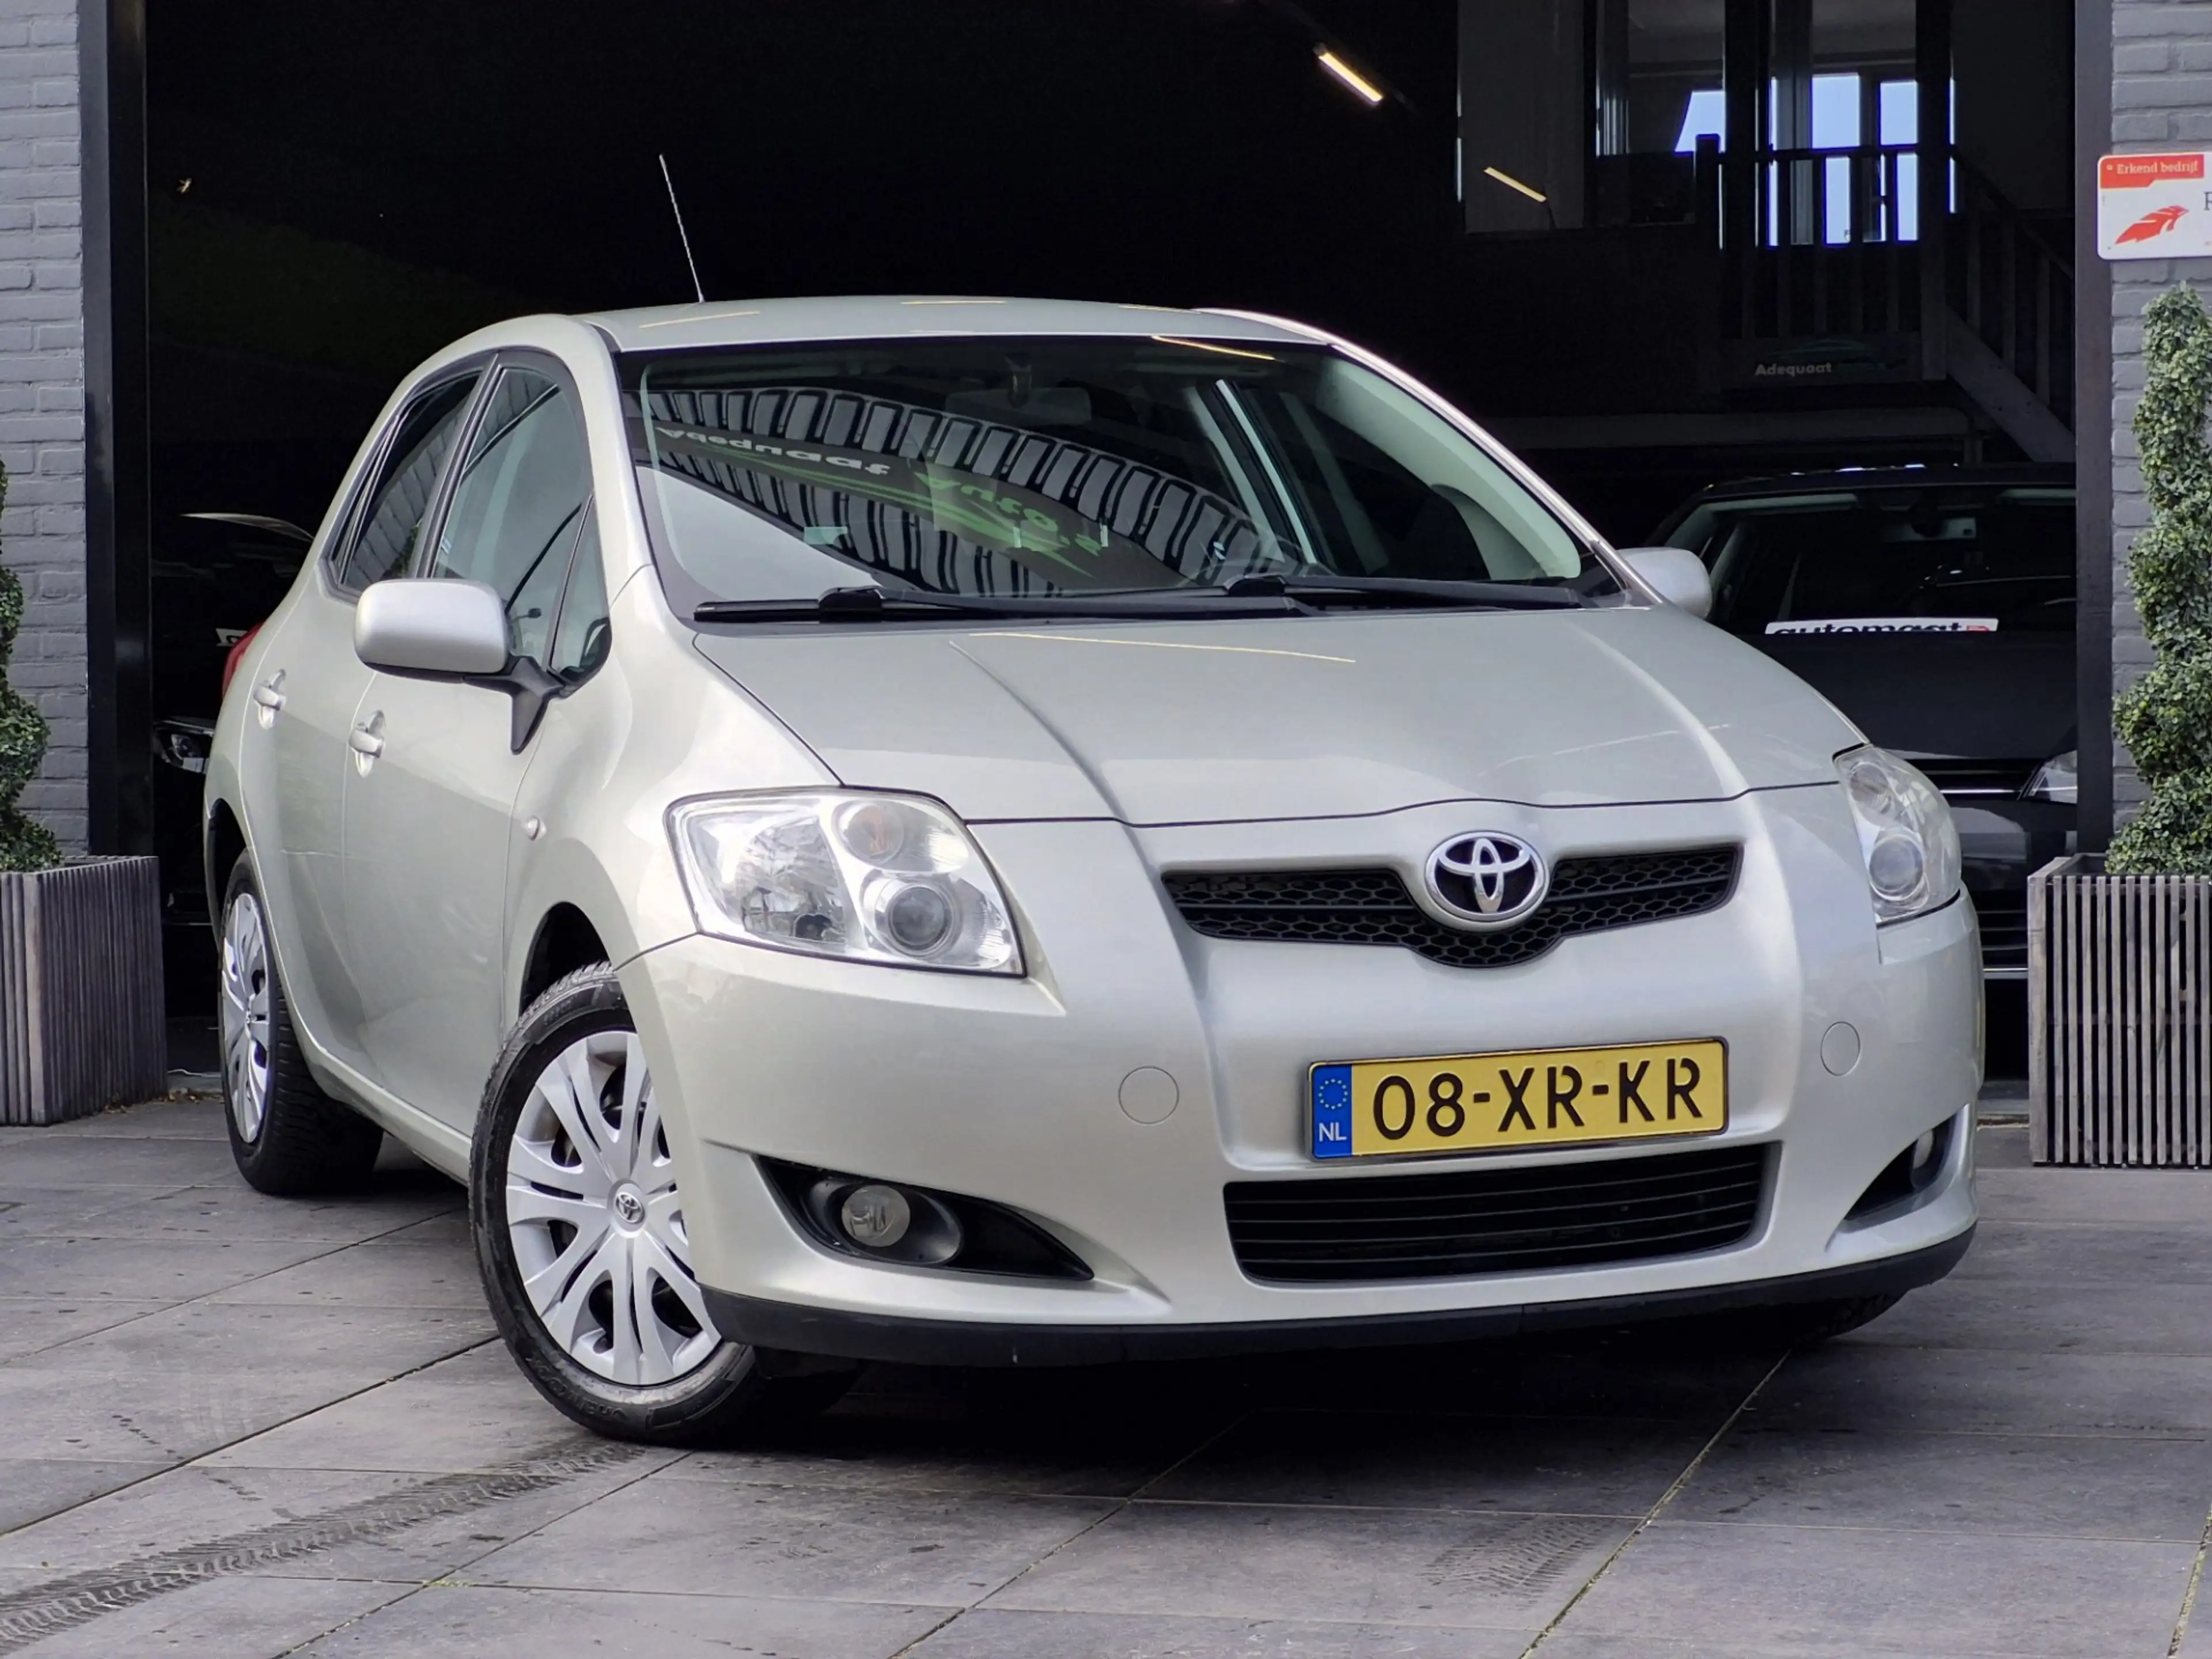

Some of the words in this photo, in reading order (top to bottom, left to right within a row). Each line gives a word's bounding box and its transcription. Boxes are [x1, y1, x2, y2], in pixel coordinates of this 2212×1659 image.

[2116, 161, 2158, 175] Erkend
[2160, 160, 2198, 174] bedrijf
[1755, 362, 1833, 376] Adequaat
[1373, 1057, 1703, 1141] 08-XR-KR
[1319, 1122, 1347, 1142] NL
